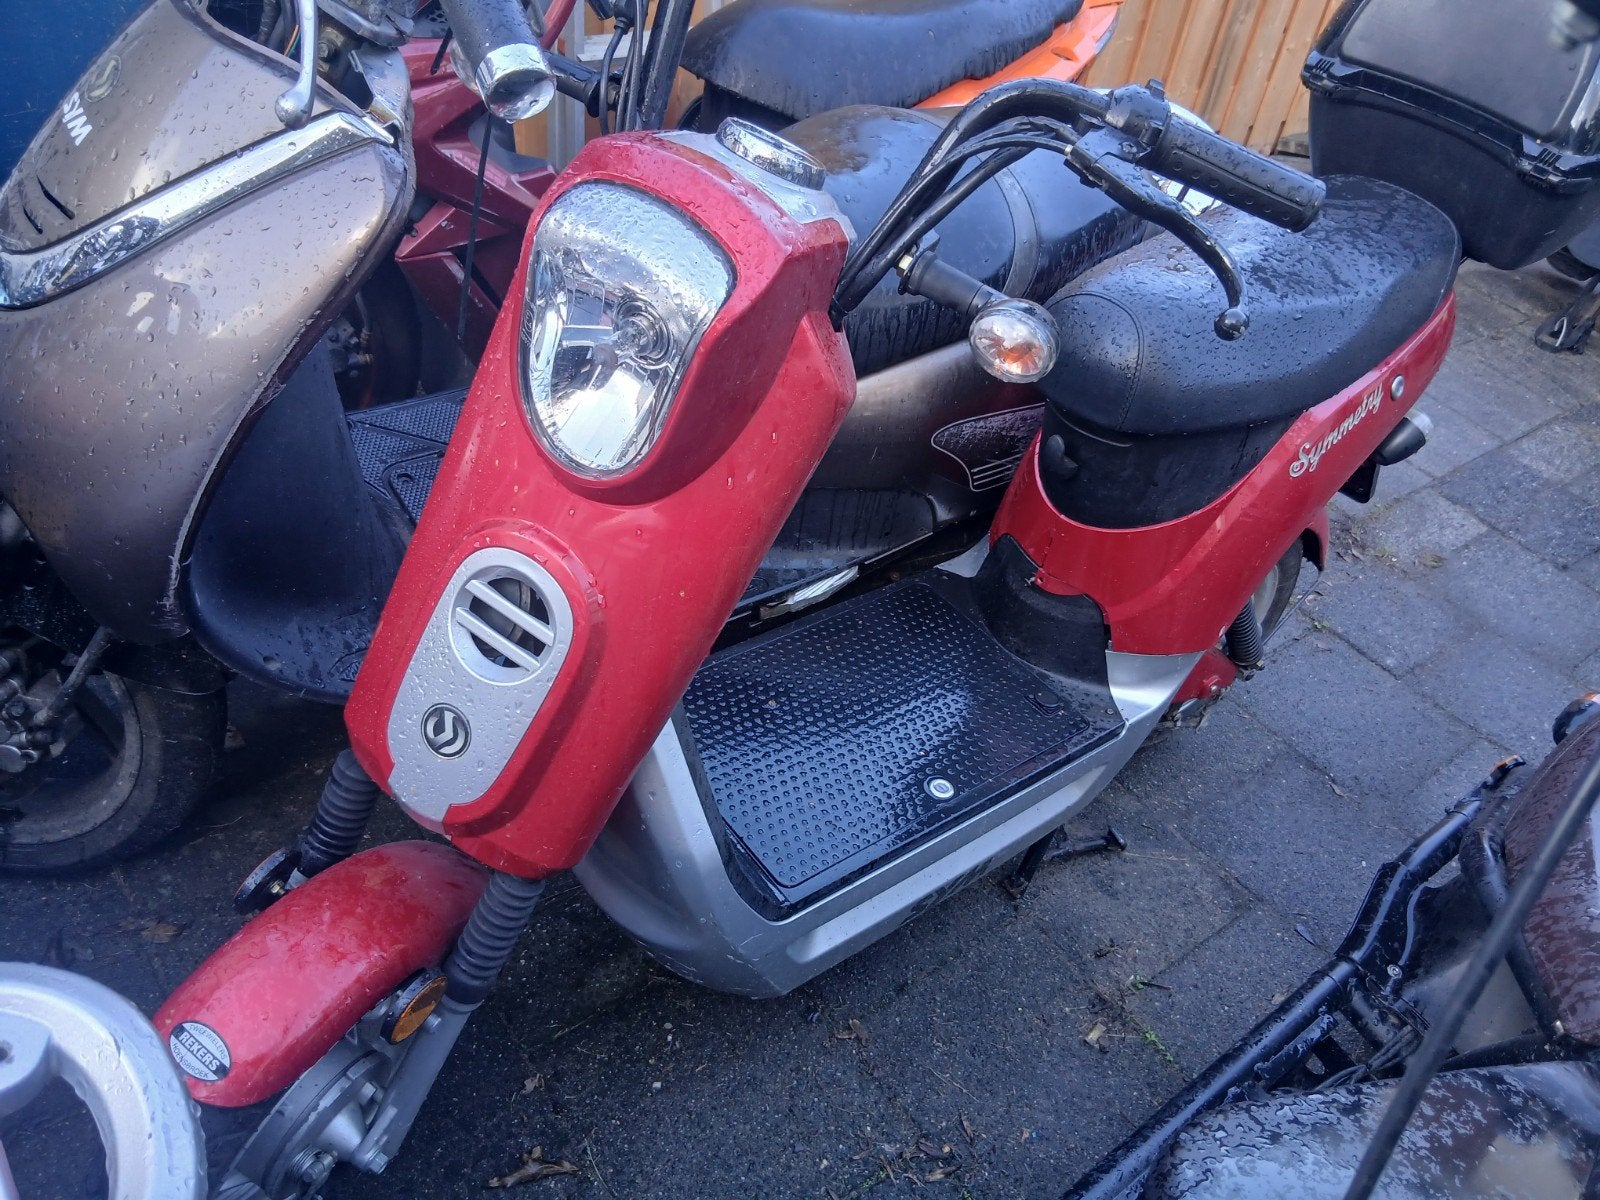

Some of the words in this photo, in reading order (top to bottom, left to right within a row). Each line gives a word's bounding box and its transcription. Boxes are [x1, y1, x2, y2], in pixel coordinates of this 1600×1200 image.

[62, 92, 93, 147] SYM
[1289, 382, 1384, 478] Symmetry
[178, 1031, 220, 1071] REKERS
